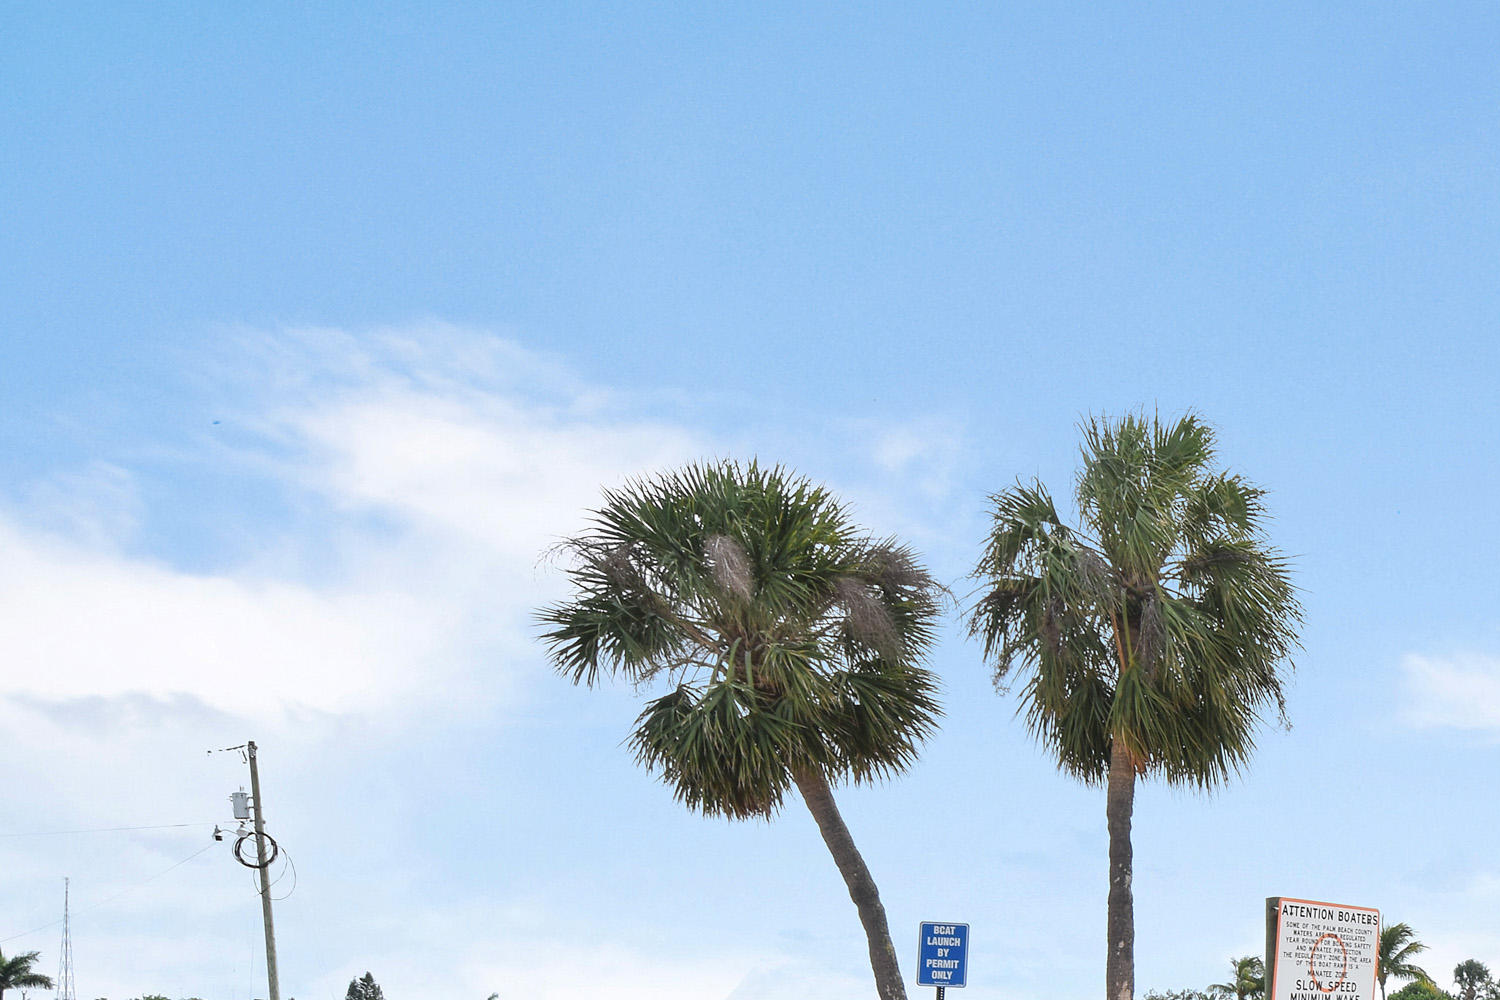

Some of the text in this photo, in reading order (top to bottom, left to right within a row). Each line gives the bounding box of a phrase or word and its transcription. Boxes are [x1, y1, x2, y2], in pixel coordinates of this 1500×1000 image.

[1282, 904, 1378, 926] ATTENTION BOATERS
[1286, 921, 1300, 929] SOME
[1338, 926, 1353, 934] BEACH
[927, 936, 960, 947] LAUNCH
[1340, 934, 1366, 942] REGULATED
[1333, 940, 1352, 948] BOATING
[1354, 942, 1372, 950] SAFETY
[937, 948, 950, 957] BY
[1309, 946, 1332, 954] MANATEE
[1334, 947, 1362, 956] PROTECTION
[1295, 952, 1327, 961] REGULATORY
[926, 959, 959, 969] PERMIT
[931, 970, 953, 980] ONLY
[1307, 970, 1348, 979] MANATEE ZONE
[1296, 979, 1357, 992] SLOW SPEED
